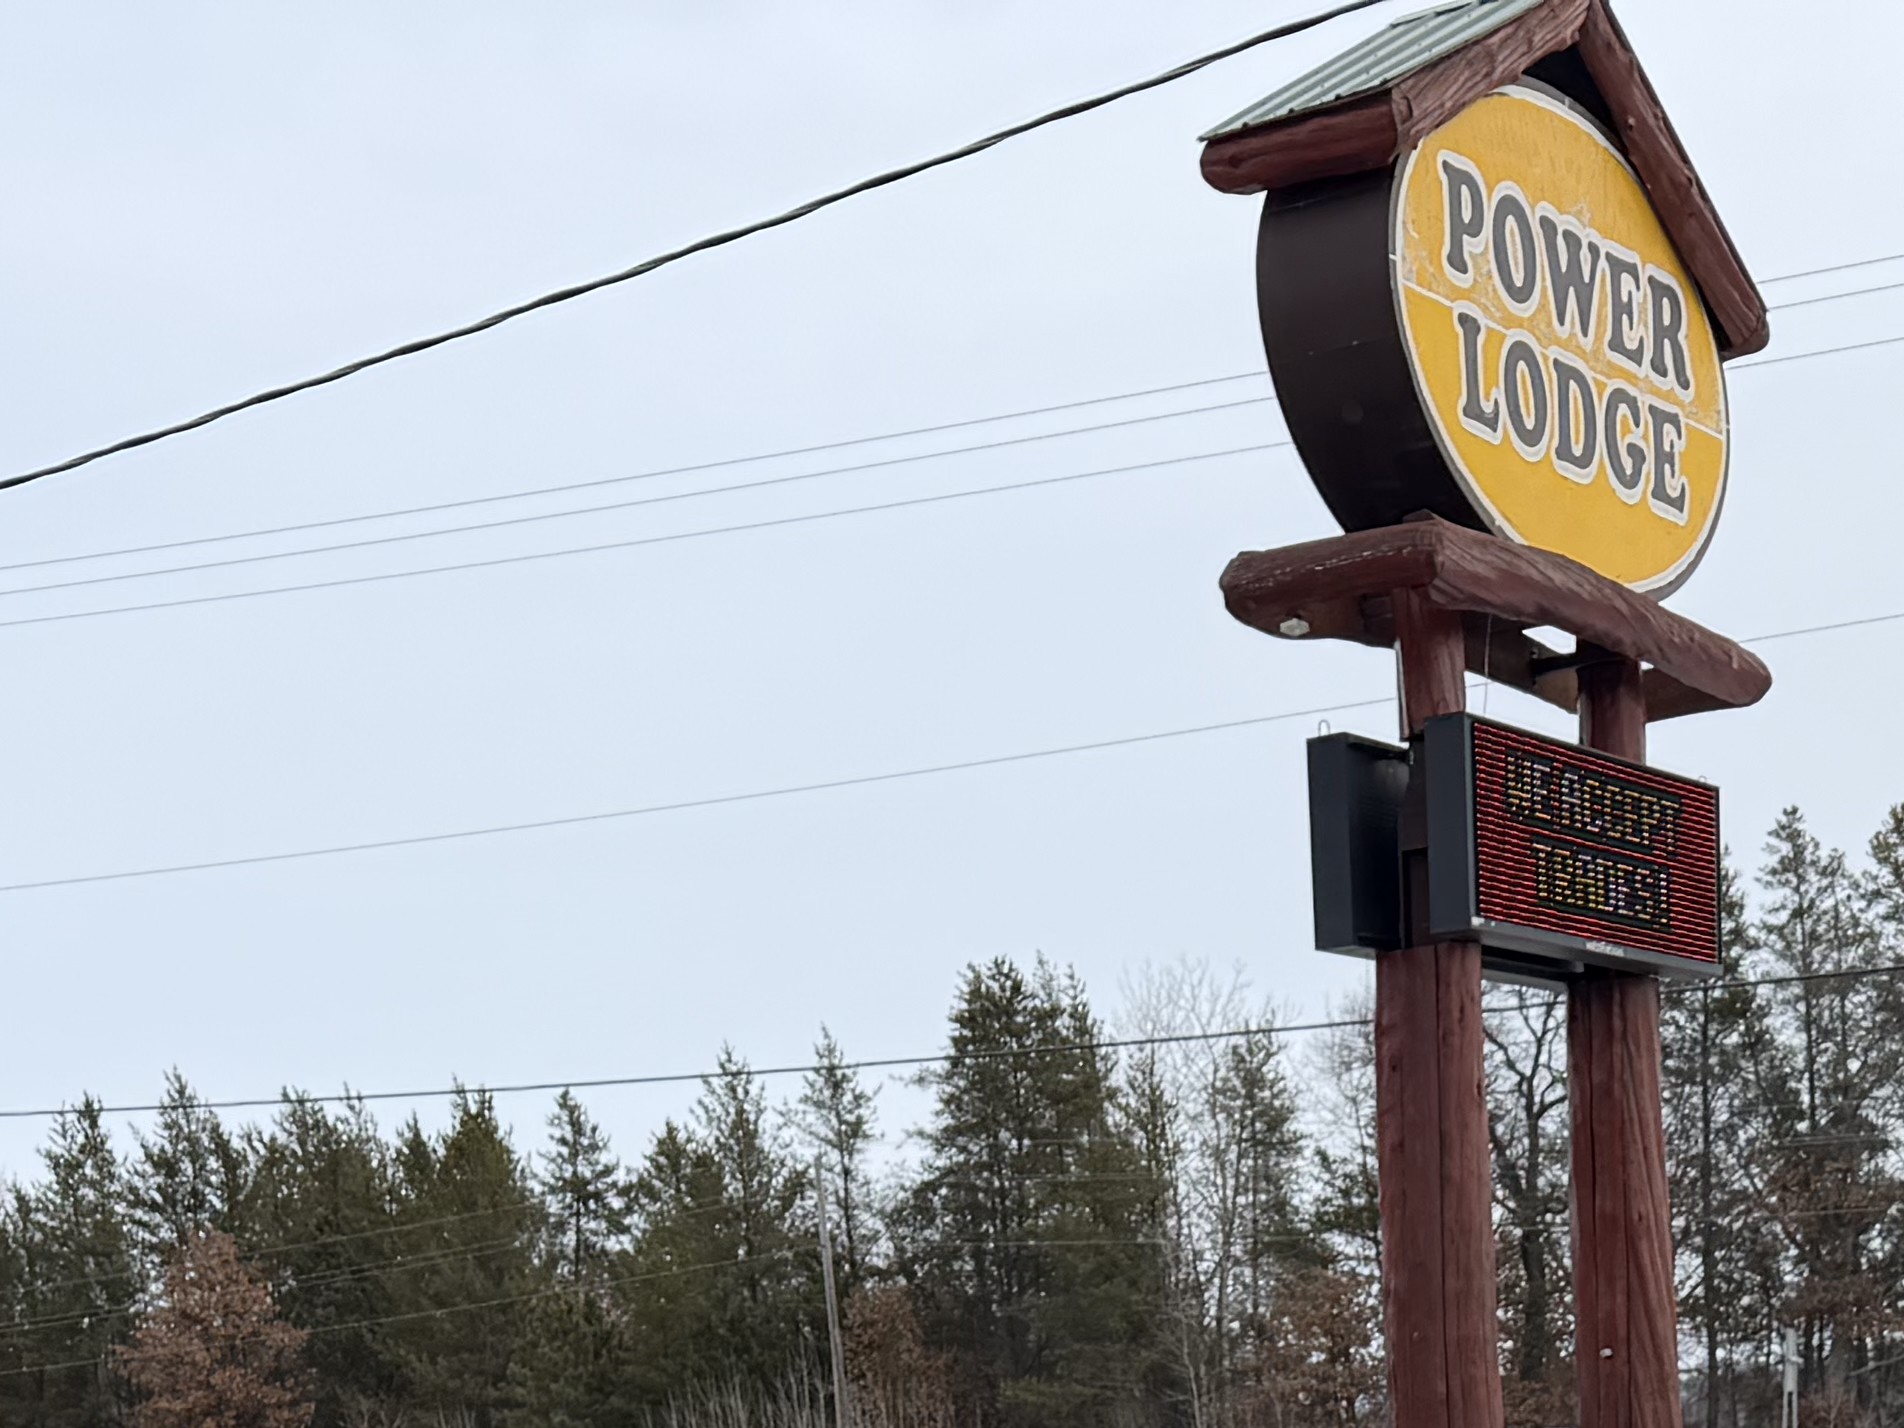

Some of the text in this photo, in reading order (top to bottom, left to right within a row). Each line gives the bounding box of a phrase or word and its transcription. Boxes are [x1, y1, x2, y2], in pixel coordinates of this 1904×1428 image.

[1437, 158, 1692, 392] POWER
[1456, 311, 1688, 514] LODGE
[1507, 754, 1680, 851] WE ACCEPT
[1532, 843, 1669, 924] TRADES!
